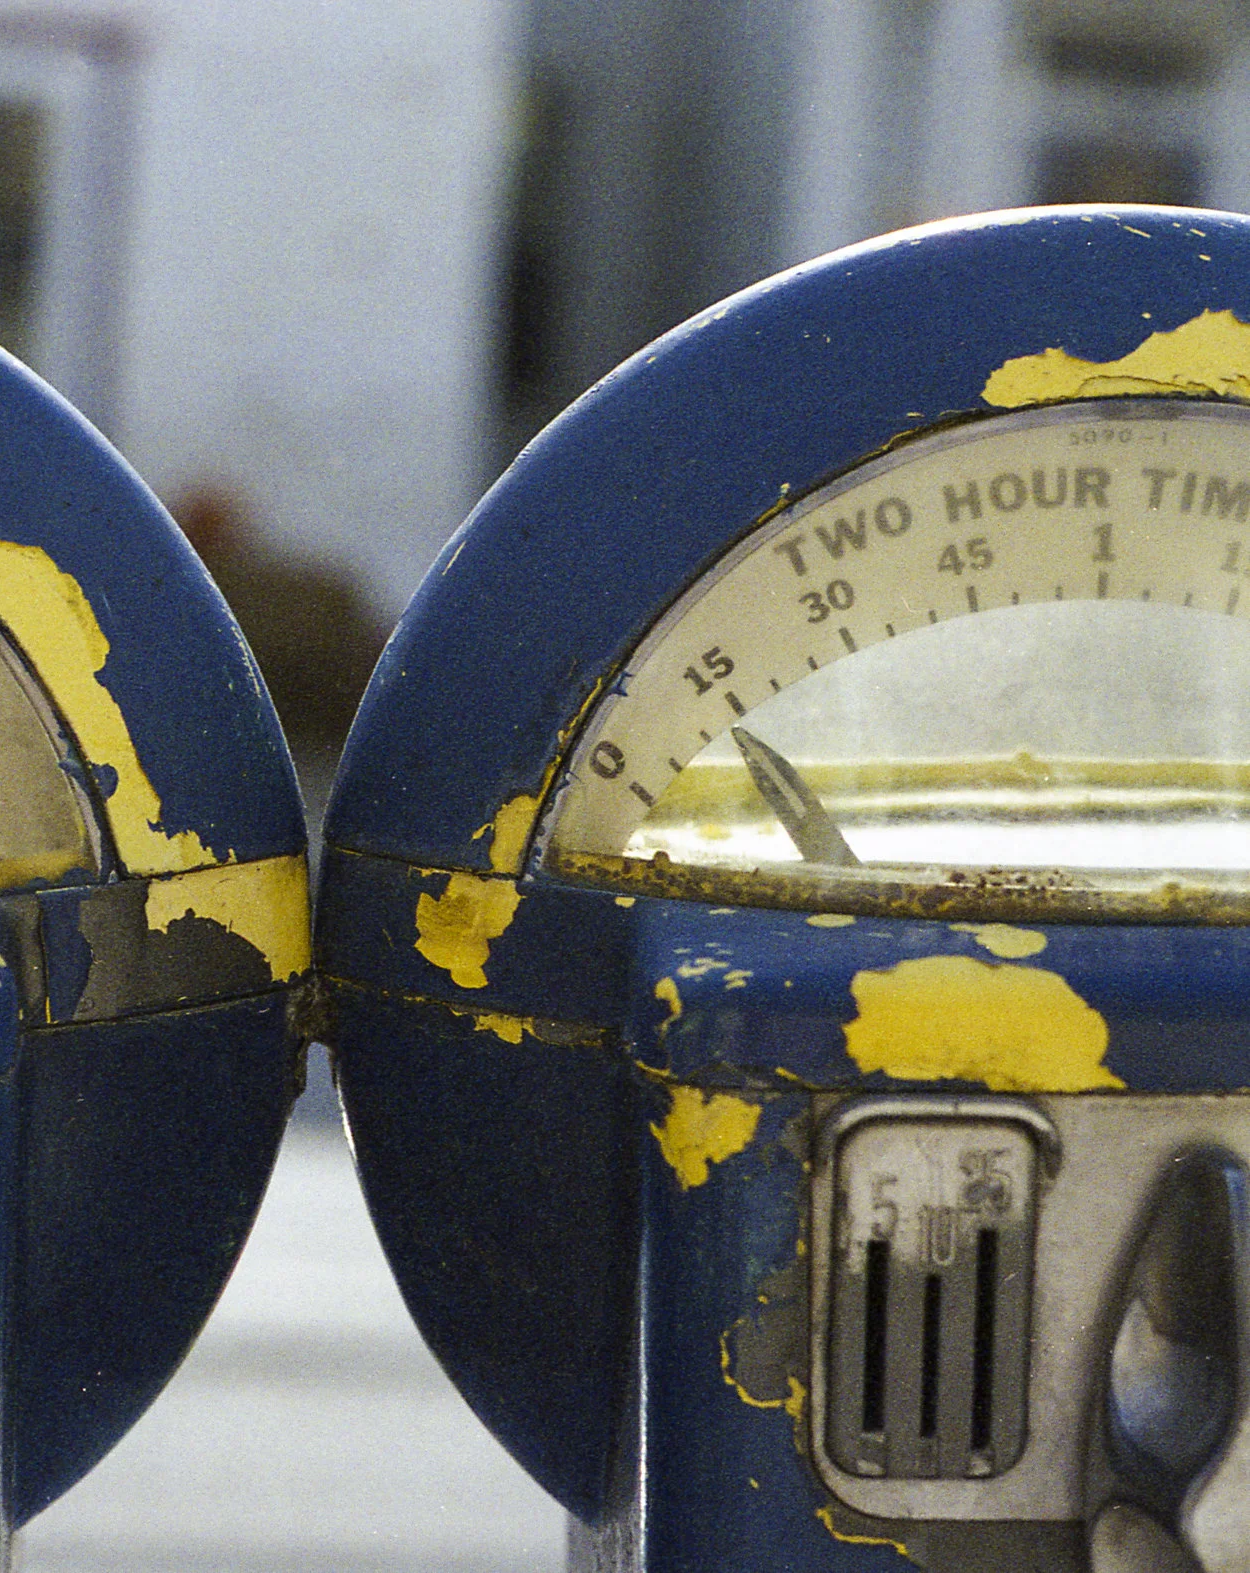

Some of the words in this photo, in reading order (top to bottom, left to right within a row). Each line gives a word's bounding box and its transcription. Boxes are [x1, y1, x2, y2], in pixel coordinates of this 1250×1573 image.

[773, 496, 913, 578] TWO
[943, 467, 1111, 523] HOUR
[1141, 467, 1250, 524] TIM
[1091, 523, 1117, 563] 1
[937, 537, 995, 576] 45
[1220, 540, 1250, 576] 1
[799, 579, 856, 624] 30
[682, 646, 736, 696] 15
[589, 739, 627, 780] 0
[870, 1173, 900, 1240] 5
